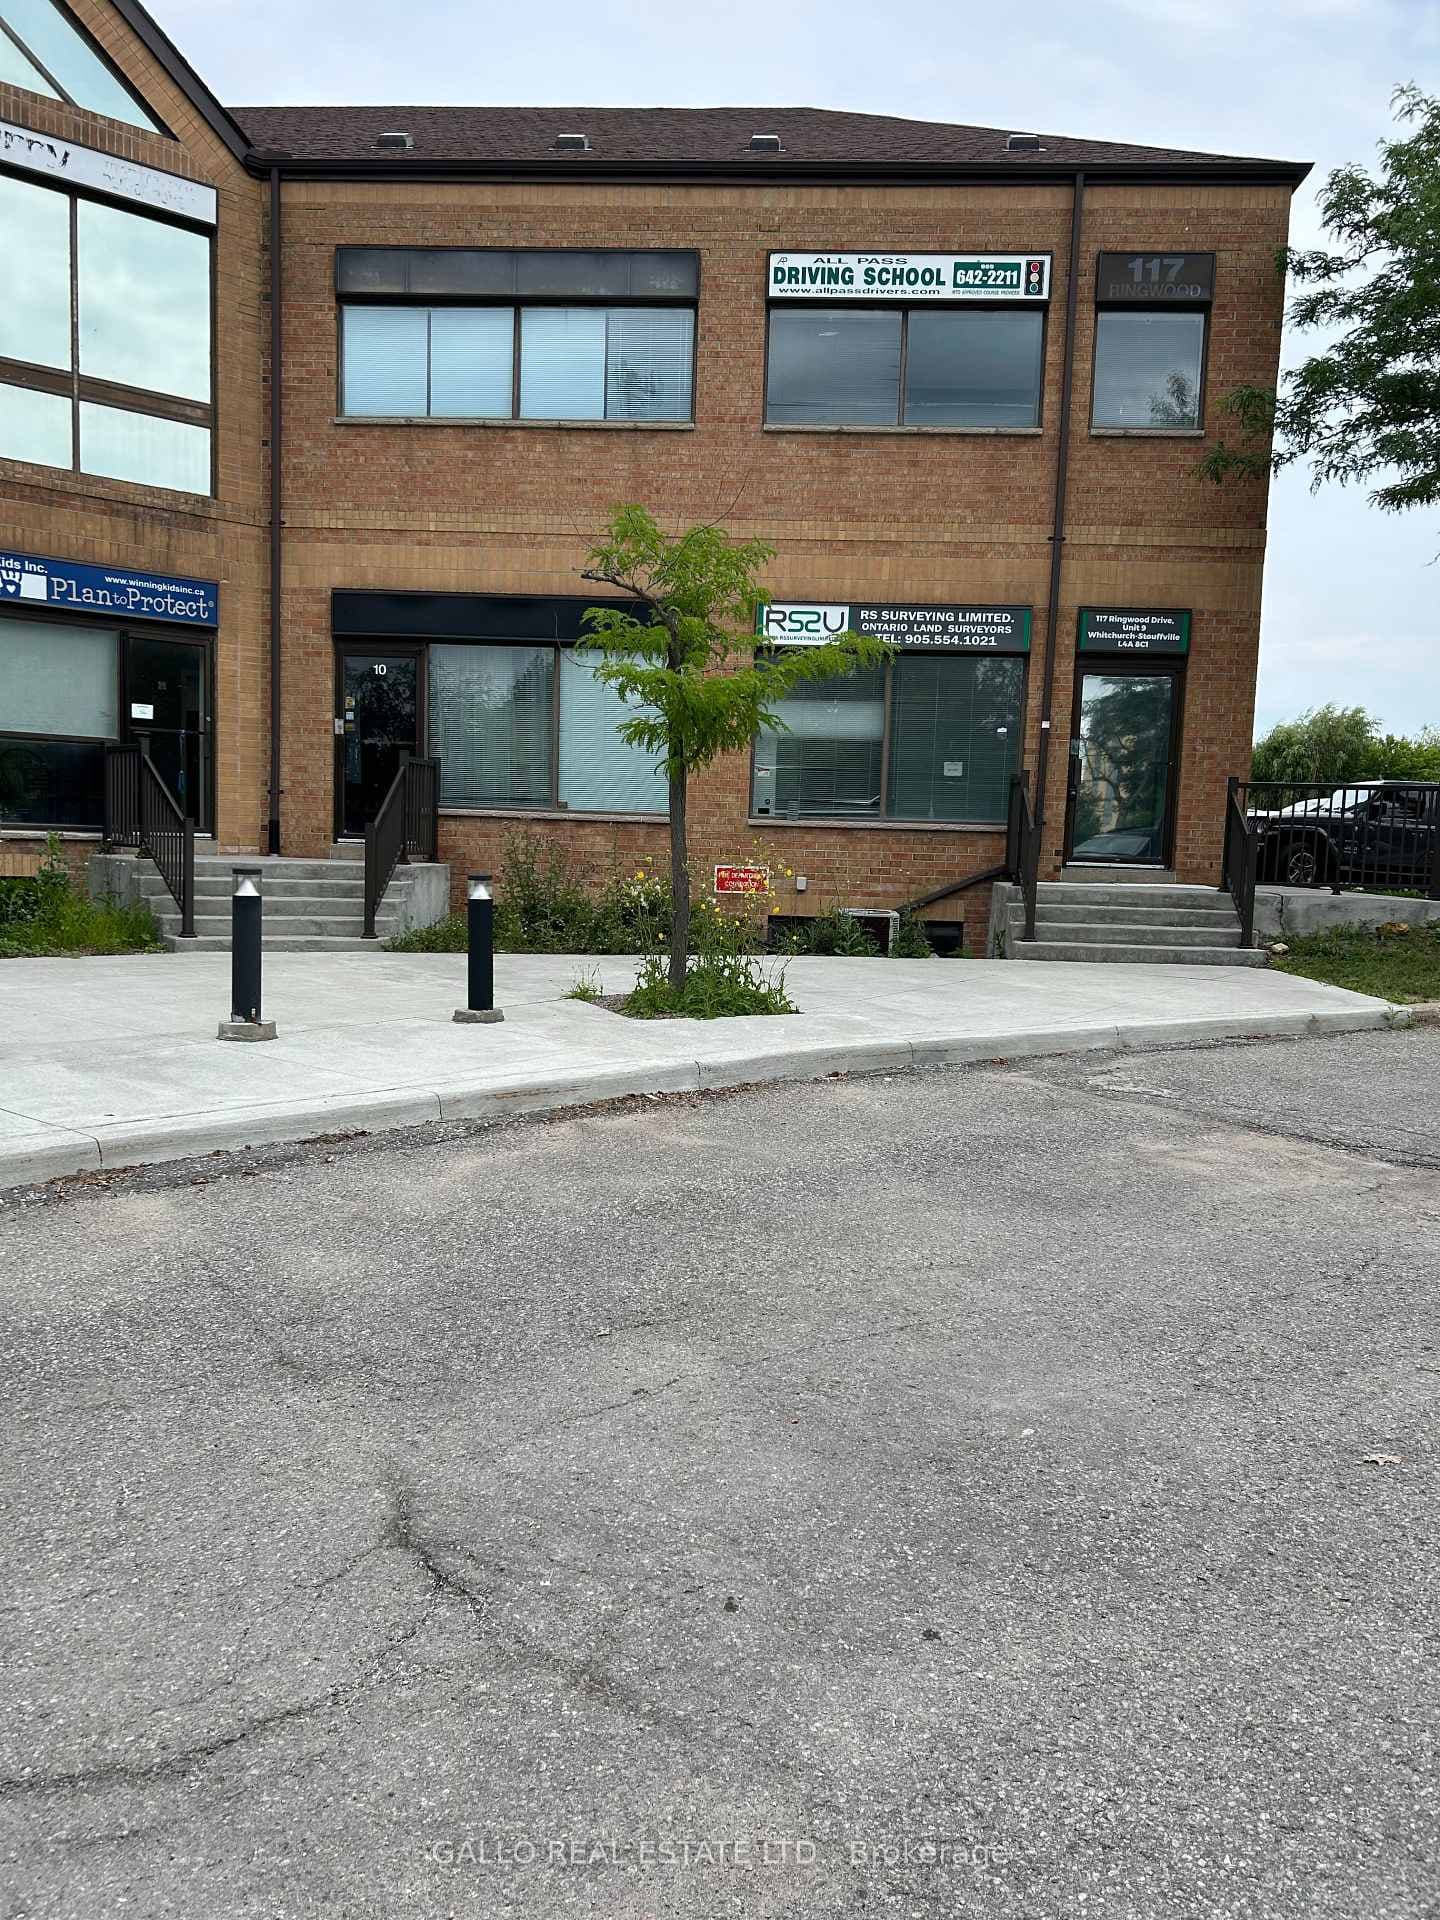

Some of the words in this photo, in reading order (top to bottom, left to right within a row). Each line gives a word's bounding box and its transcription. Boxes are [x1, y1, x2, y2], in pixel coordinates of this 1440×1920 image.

[858, 257, 908, 265] PASS
[773, 266, 854, 285] DRIVING
[863, 267, 946, 286] SCHOOL
[1128, 258, 1184, 282] 117
[956, 269, 1018, 285] 642-2211
[779, 287, 941, 296] www.allpassdrivers.com
[0, 557, 21, 570] ids
[25, 560, 48, 574] Inc.
[50, 577, 113, 606] Plan
[112, 592, 127, 605] to
[104, 575, 205, 596] www.winningkidsinc.ca
[860, 610, 878, 620] RS
[881, 611, 955, 622] SURVEYING
[958, 612, 1015, 623] LIMITED.
[1095, 615, 1109, 623] 117
[1109, 614, 1150, 624] Ringwood
[1151, 616, 1175, 625] Drive,
[861, 623, 908, 632] ONTARIO
[913, 624, 943, 633] LAND
[947, 625, 1012, 634] SURVEYORS
[874, 633, 901, 644] TEL:
[905, 634, 998, 646] 905.554.1021
[1087, 631, 1180, 641] Whitchurch-Stouffville
[1118, 640, 1133, 648] L4A
[373, 664, 387, 675] 10
